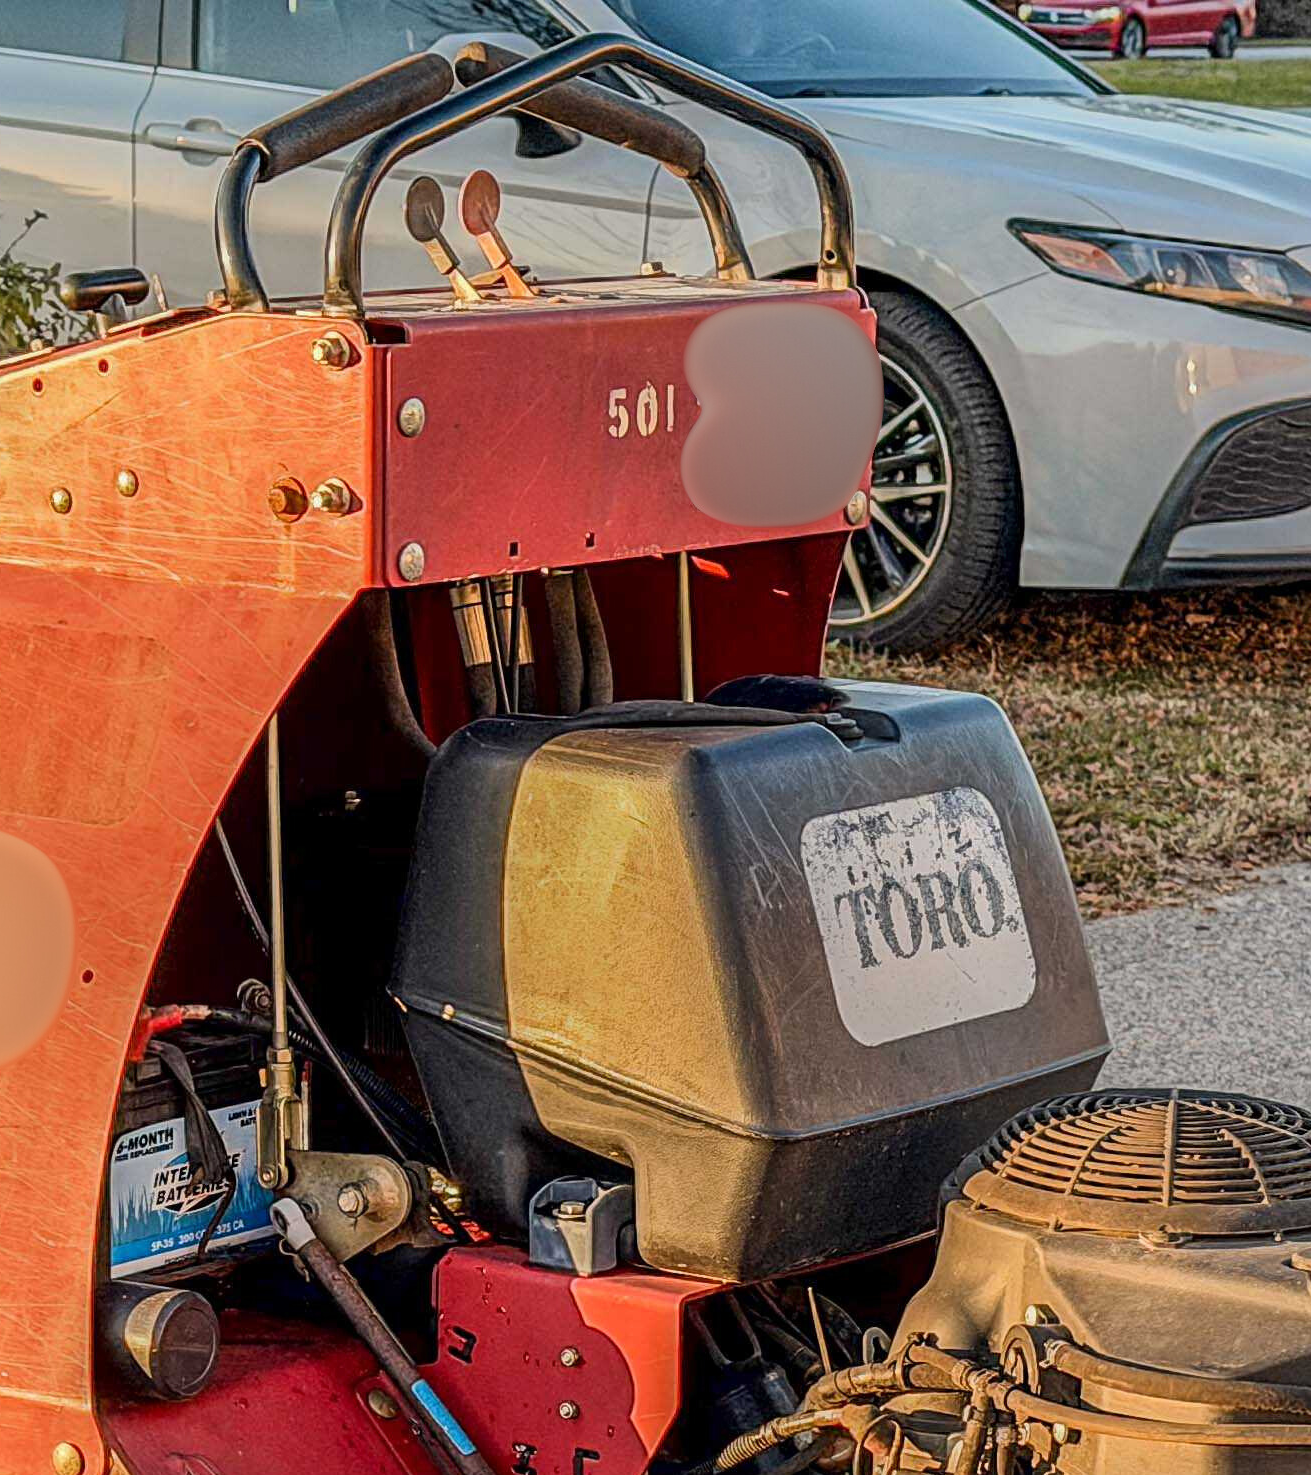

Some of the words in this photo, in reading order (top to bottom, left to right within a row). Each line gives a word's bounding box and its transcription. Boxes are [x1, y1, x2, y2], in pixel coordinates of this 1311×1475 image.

[608, 381, 675, 438] 501
[834, 860, 1005, 969] TORO
[116, 1127, 174, 1154] 6-MONTH
[153, 1153, 241, 1188] INTEE
